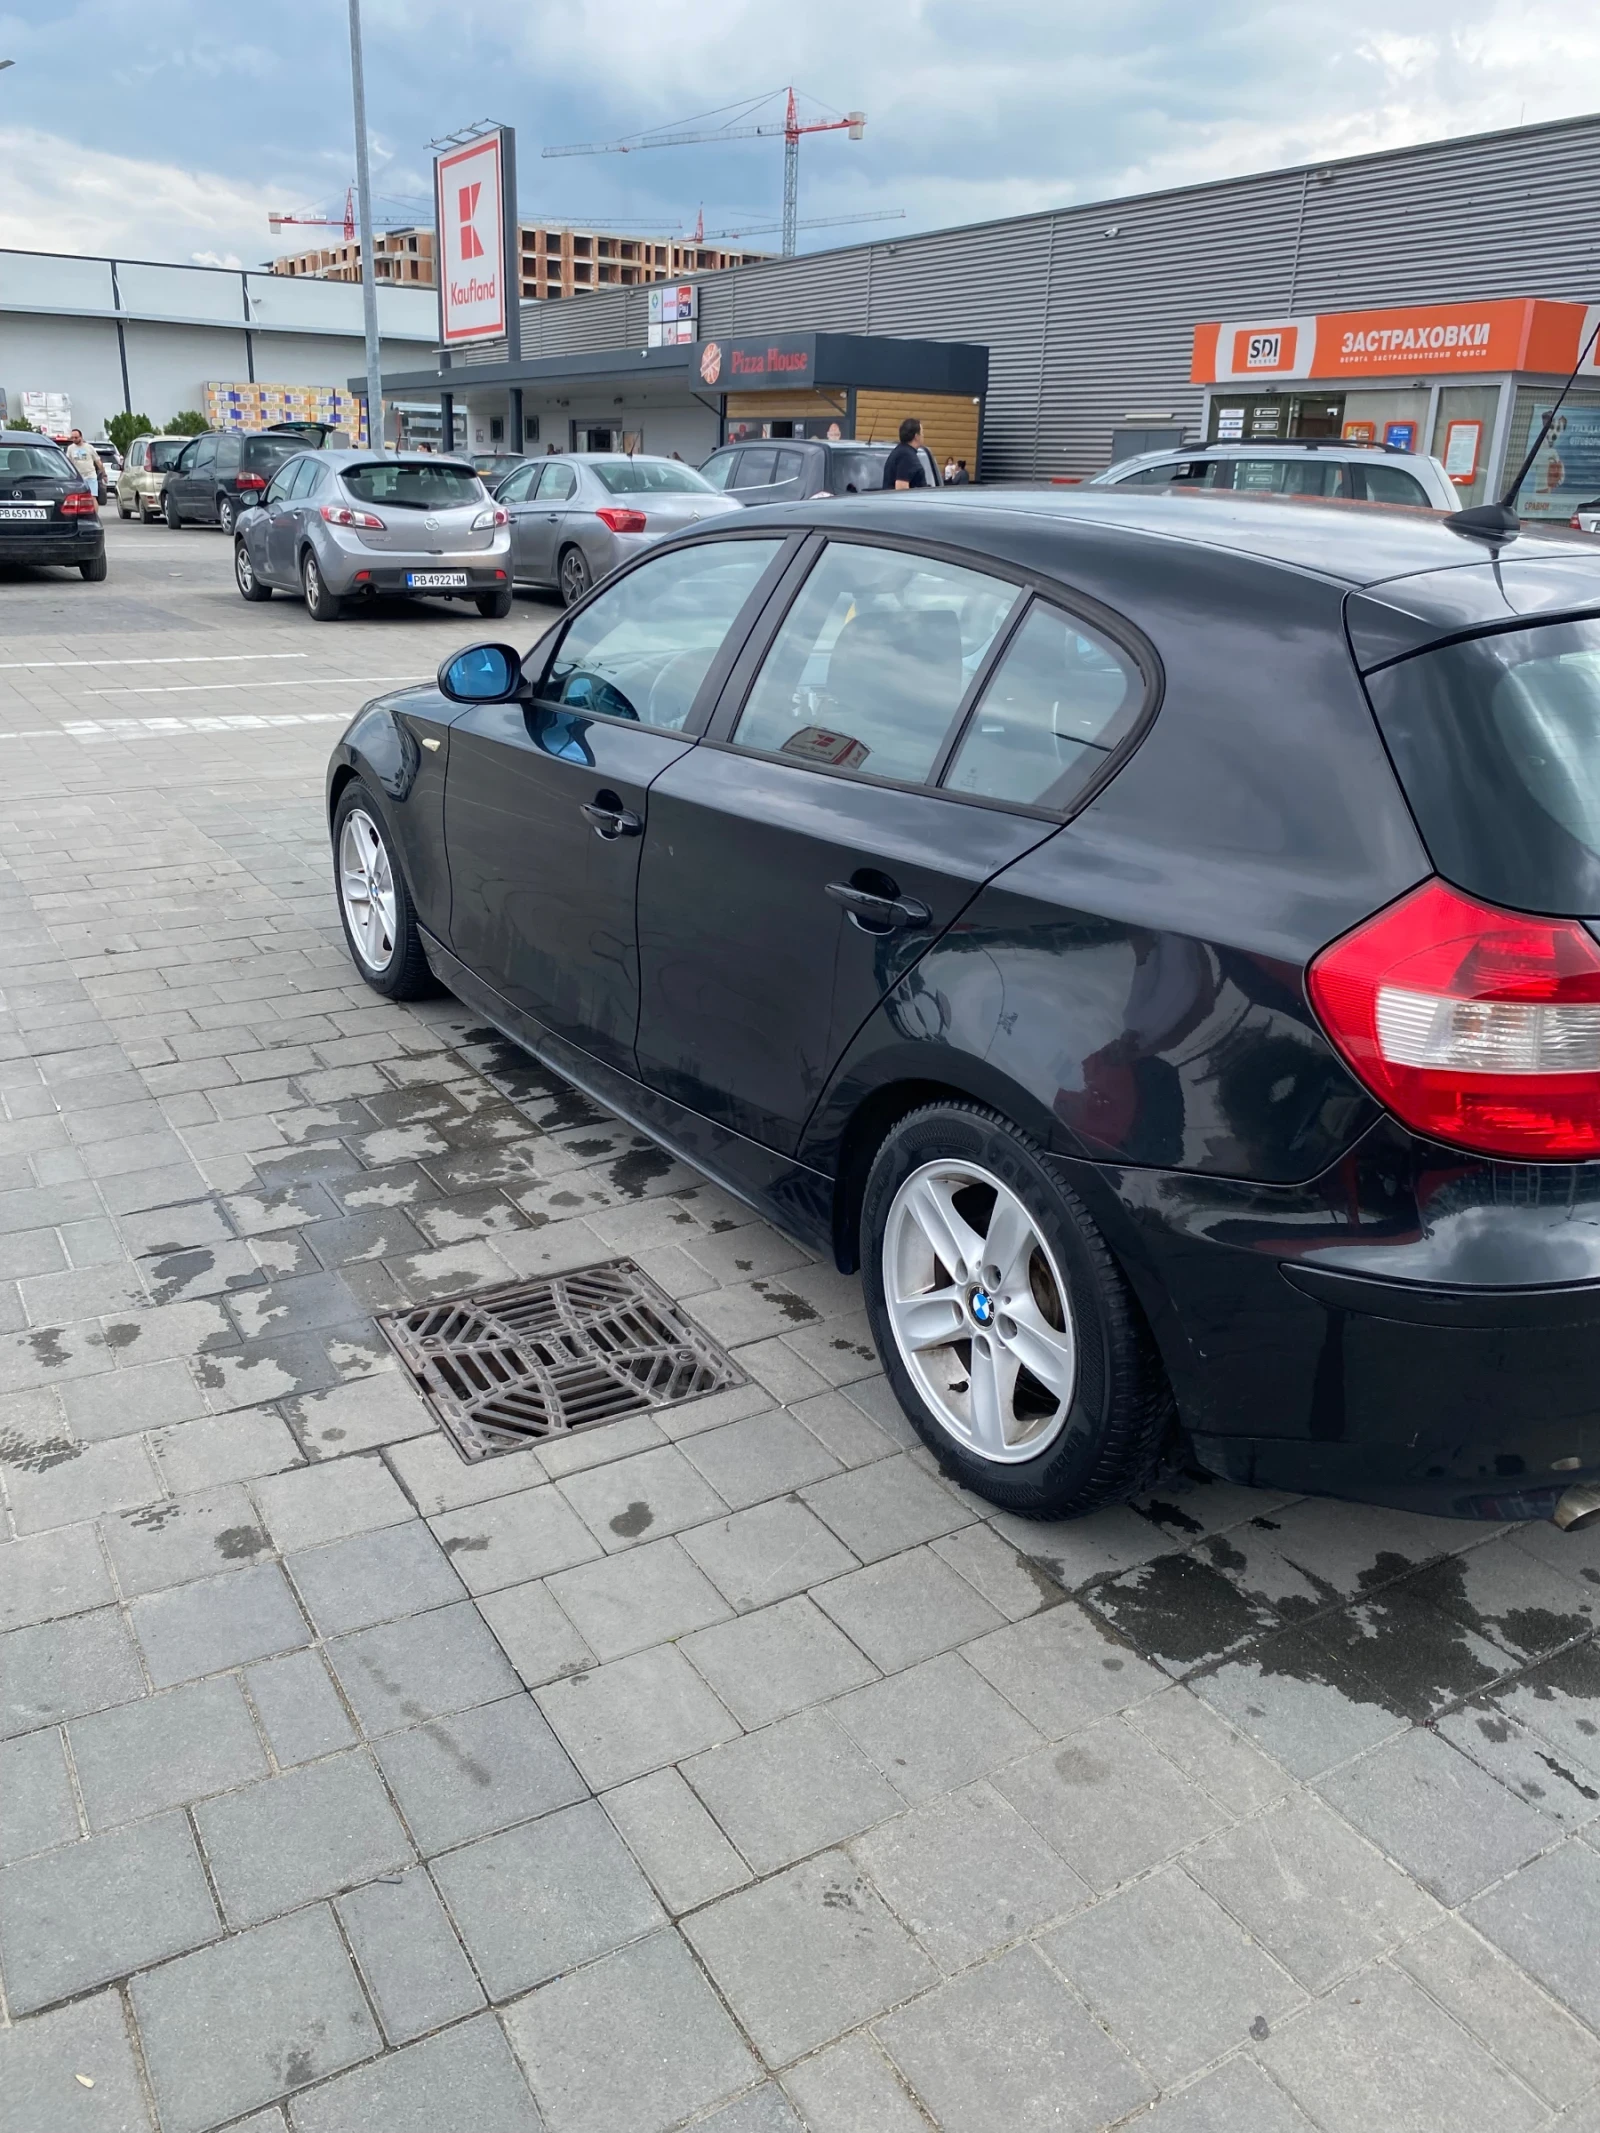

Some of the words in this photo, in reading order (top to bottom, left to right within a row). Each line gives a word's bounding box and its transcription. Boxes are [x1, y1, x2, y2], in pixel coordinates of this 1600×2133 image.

[451, 273, 495, 306] Kaufland
[679, 304, 689, 316] Pay
[1250, 338, 1278, 358] SDI
[1341, 323, 1490, 353] ЗАСТРАХОВКИ
[732, 350, 764, 374] Pizza
[767, 348, 807, 372] House
[12, 509, 32, 518] 6591
[34, 509, 45, 518] XX
[414, 575, 427, 586] PB
[428, 575, 451, 586] 4922
[452, 575, 465, 585] HM
